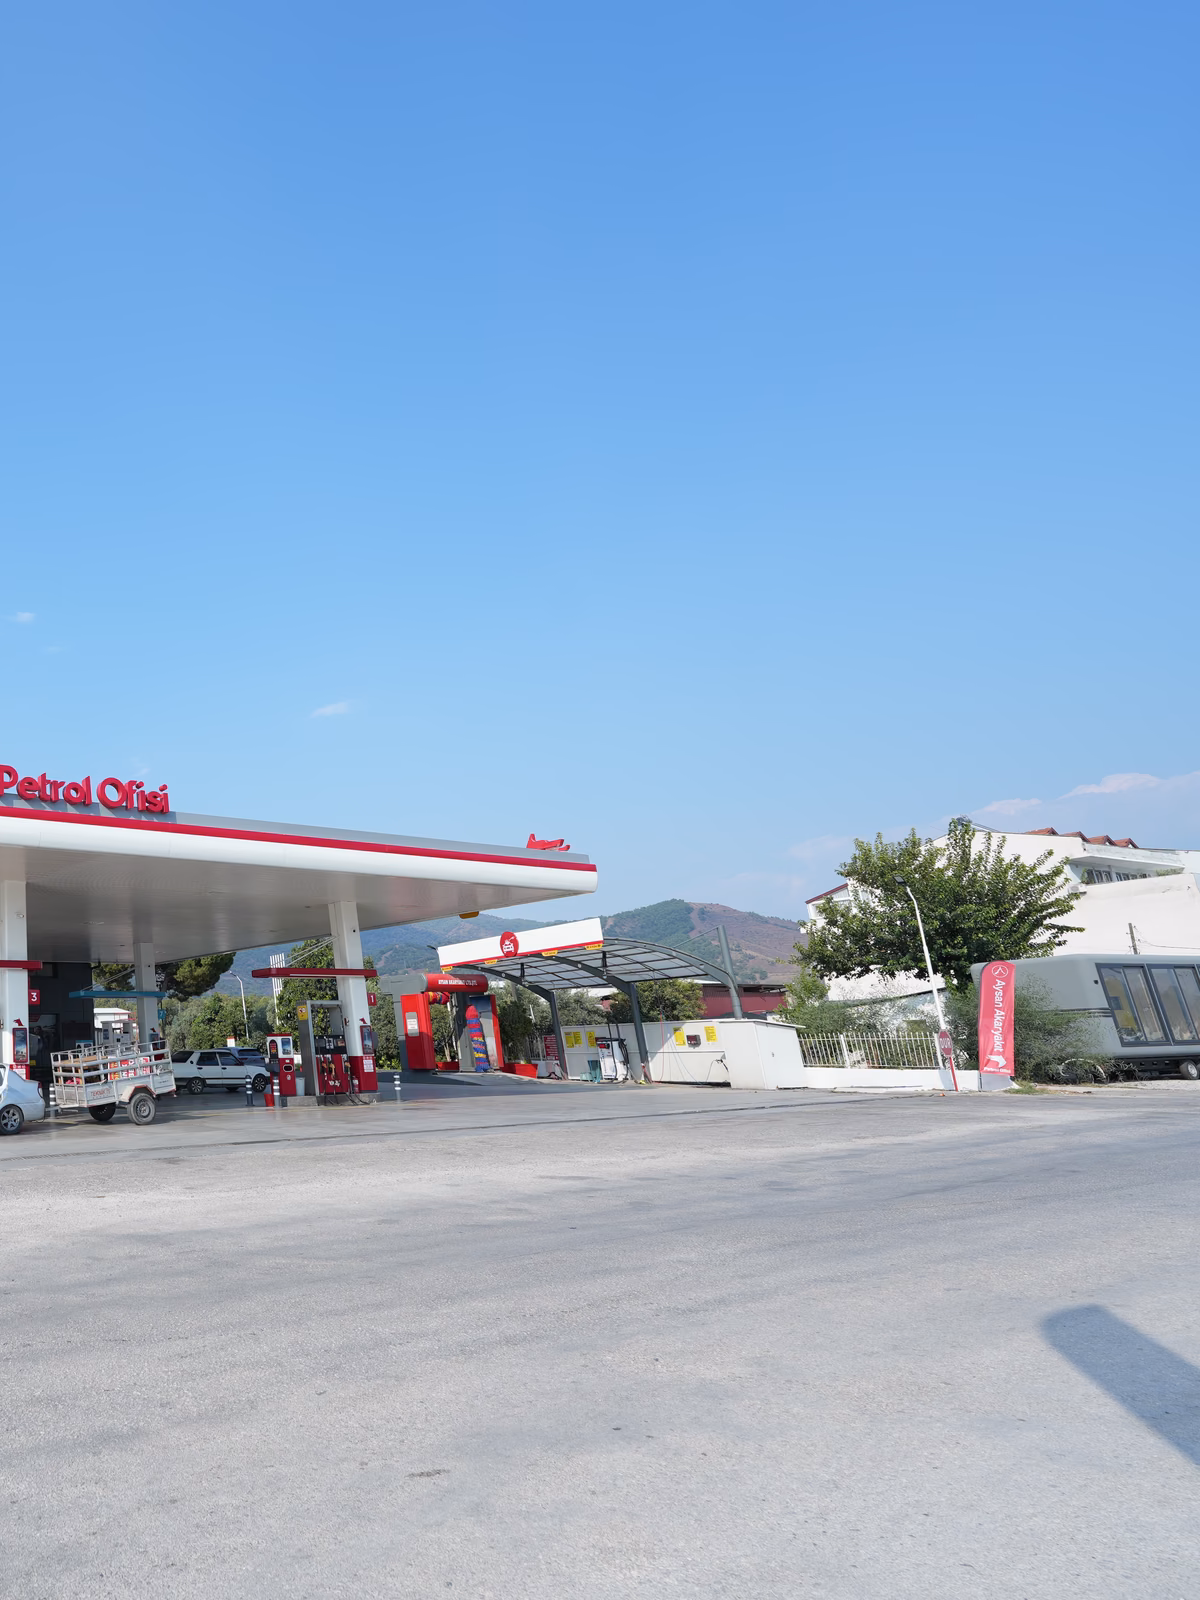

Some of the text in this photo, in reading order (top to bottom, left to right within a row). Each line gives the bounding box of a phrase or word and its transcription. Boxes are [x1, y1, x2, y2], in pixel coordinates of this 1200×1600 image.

[96, 776, 171, 814] Ofisi
[31, 993, 37, 1002] 3
[992, 979, 1006, 1007] Aysan
